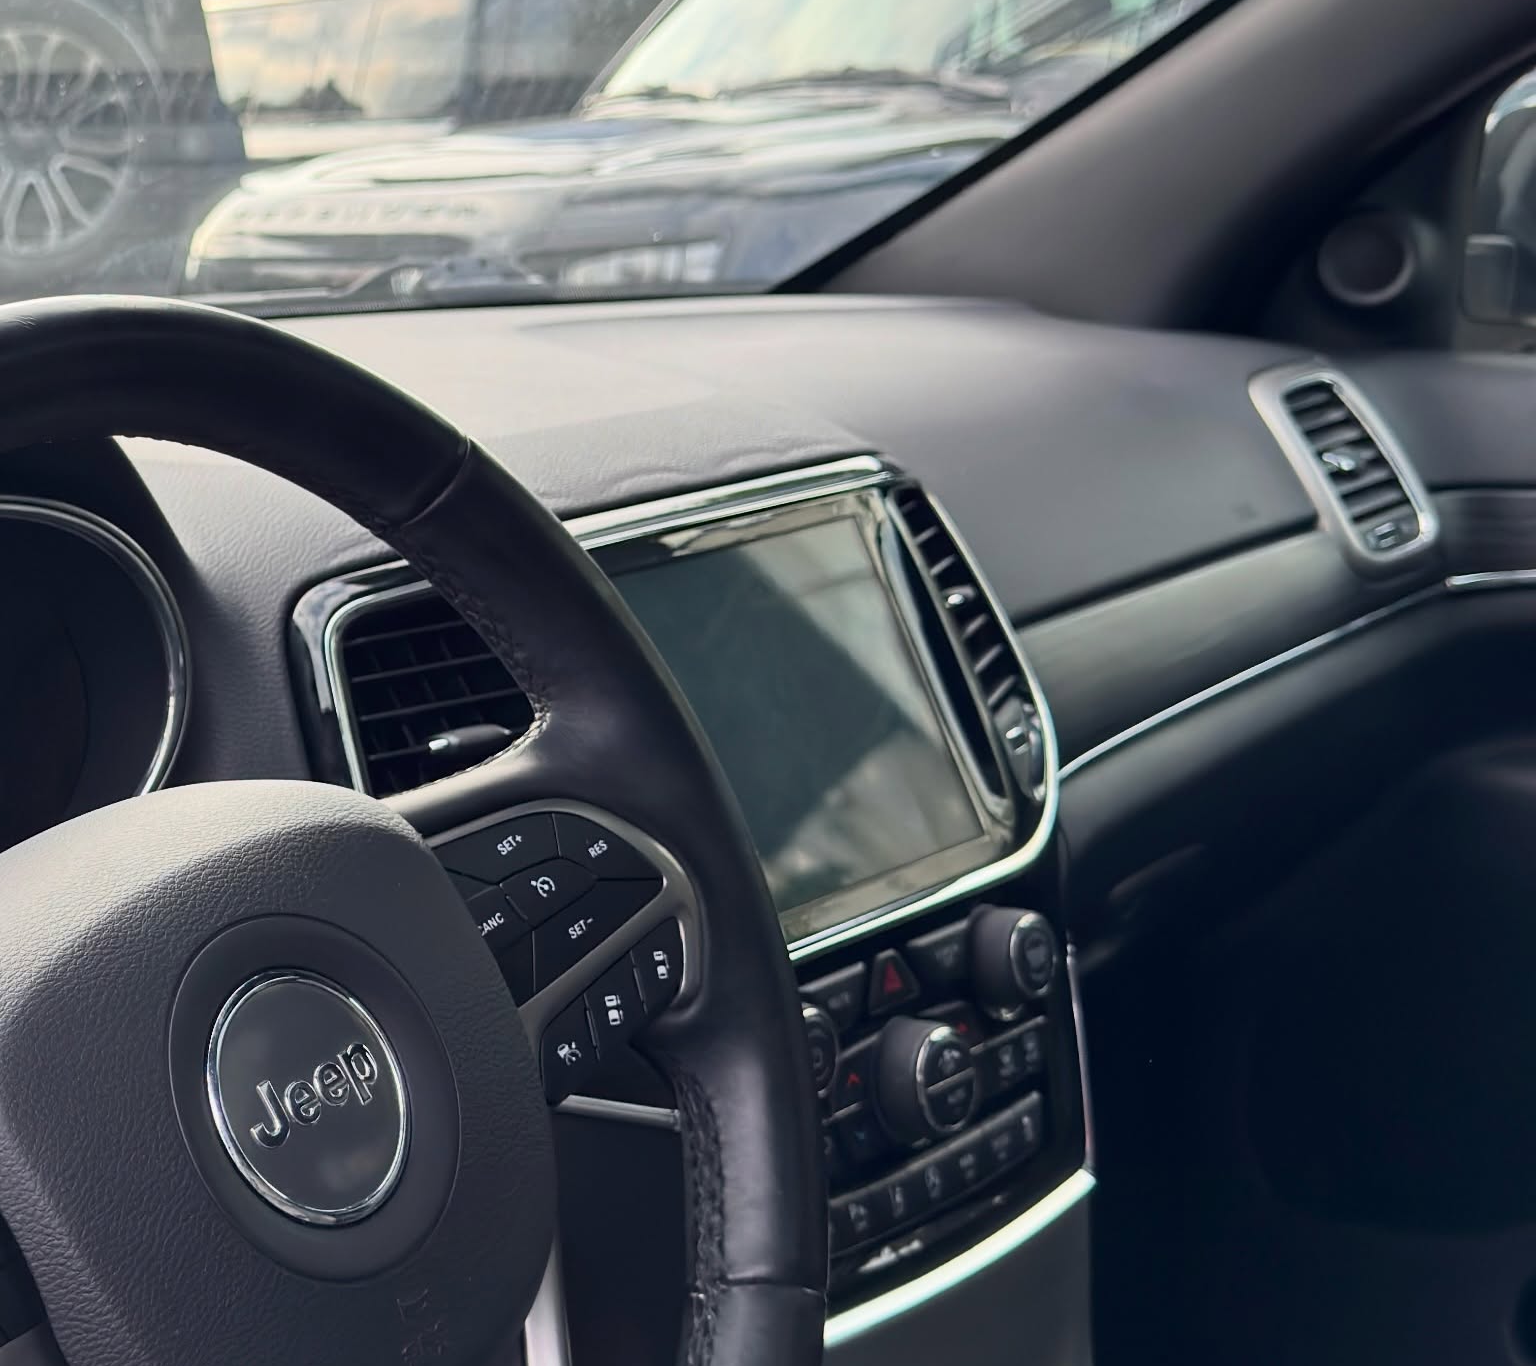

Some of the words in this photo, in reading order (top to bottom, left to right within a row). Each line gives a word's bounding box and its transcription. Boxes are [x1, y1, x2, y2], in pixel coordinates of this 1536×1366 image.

[497, 834, 522, 855] SET+
[587, 839, 608, 858] RES
[250, 1042, 378, 1149] Jeep
